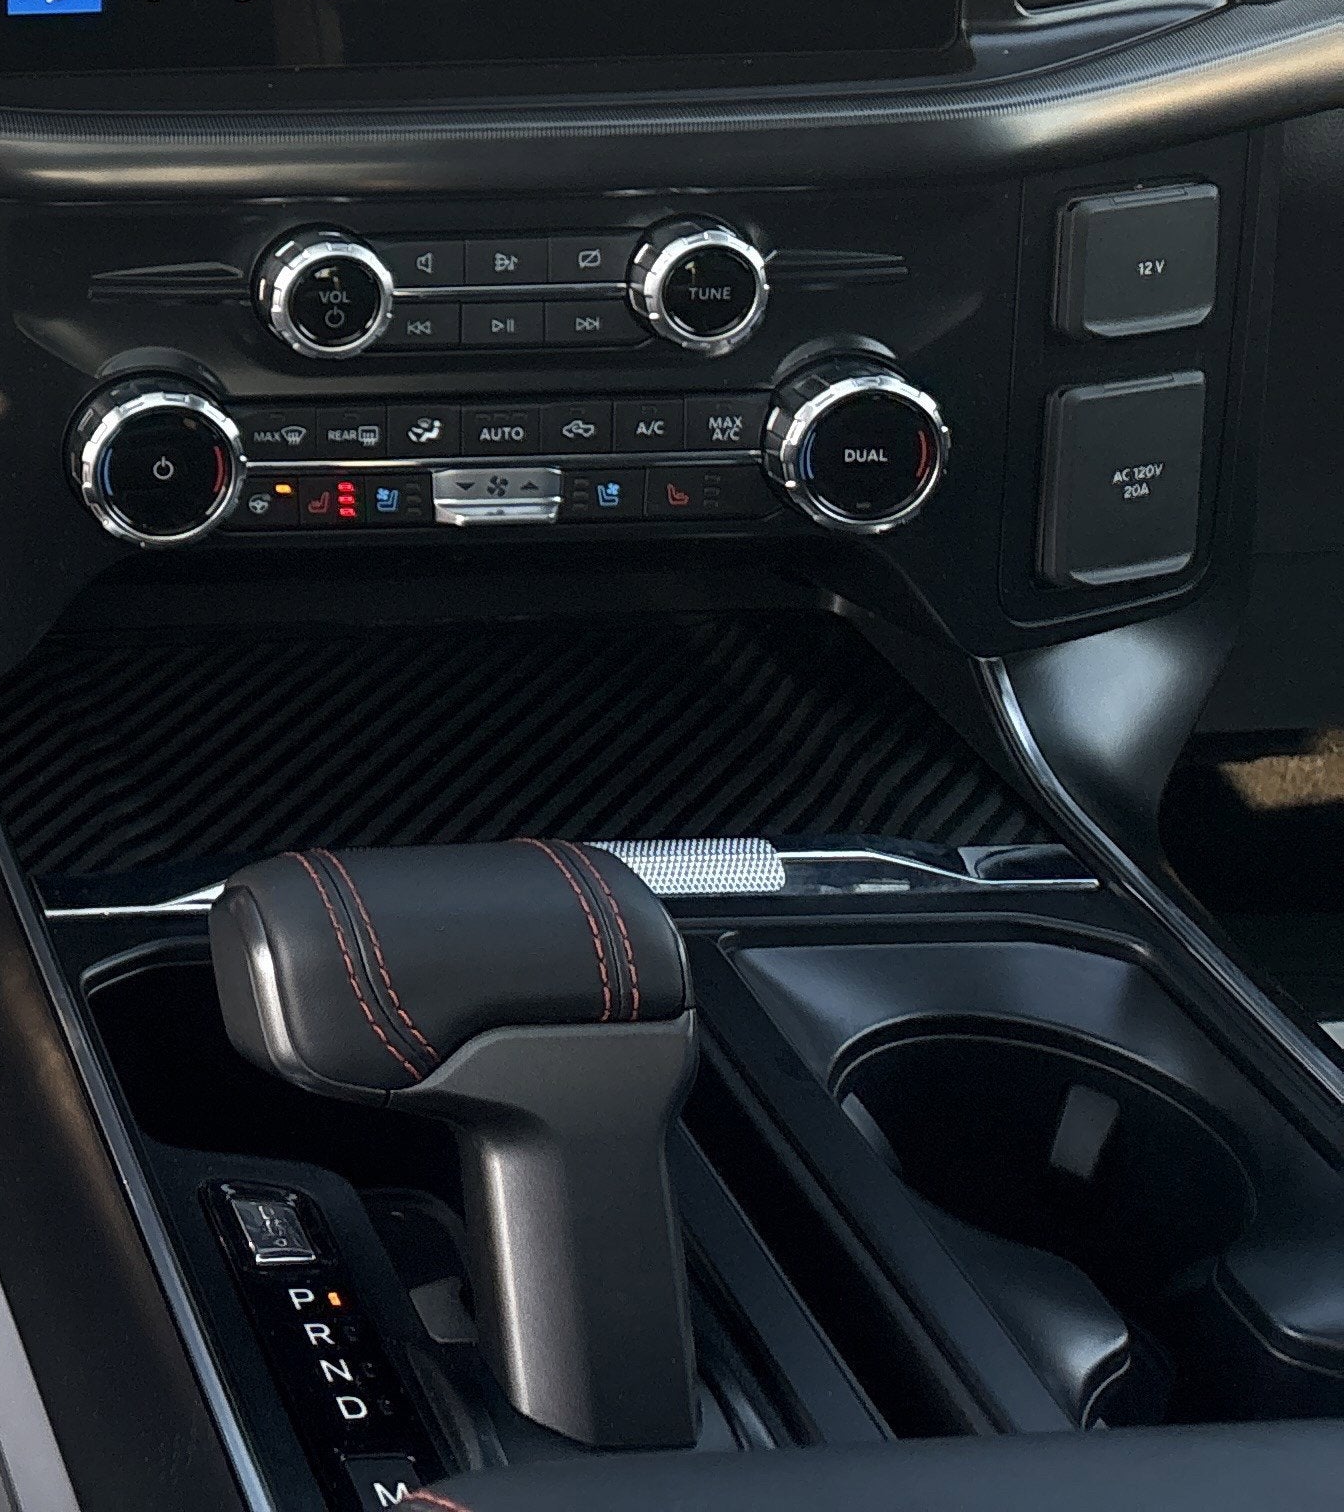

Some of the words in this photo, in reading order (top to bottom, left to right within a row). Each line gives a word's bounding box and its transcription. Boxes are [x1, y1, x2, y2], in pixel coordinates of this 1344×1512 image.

[1137, 261, 1154, 276] 12
[319, 290, 351, 304] VOL
[688, 286, 731, 301] TUNE
[636, 420, 665, 437] A/C
[709, 416, 742, 431] MAX
[254, 429, 281, 442] MAX
[328, 429, 357, 441] REAR
[480, 426, 524, 441] AUTO
[712, 427, 740, 442] A/C
[844, 448, 887, 463] DUAL
[1113, 468, 1130, 484] AC
[1134, 462, 1163, 481] 120V
[1124, 483, 1150, 499] 20A
[288, 1288, 315, 1310] P
[304, 1323, 335, 1346] R
[320, 1359, 354, 1382] N
[336, 1396, 368, 1420] D
[373, 1481, 410, 1507] M
